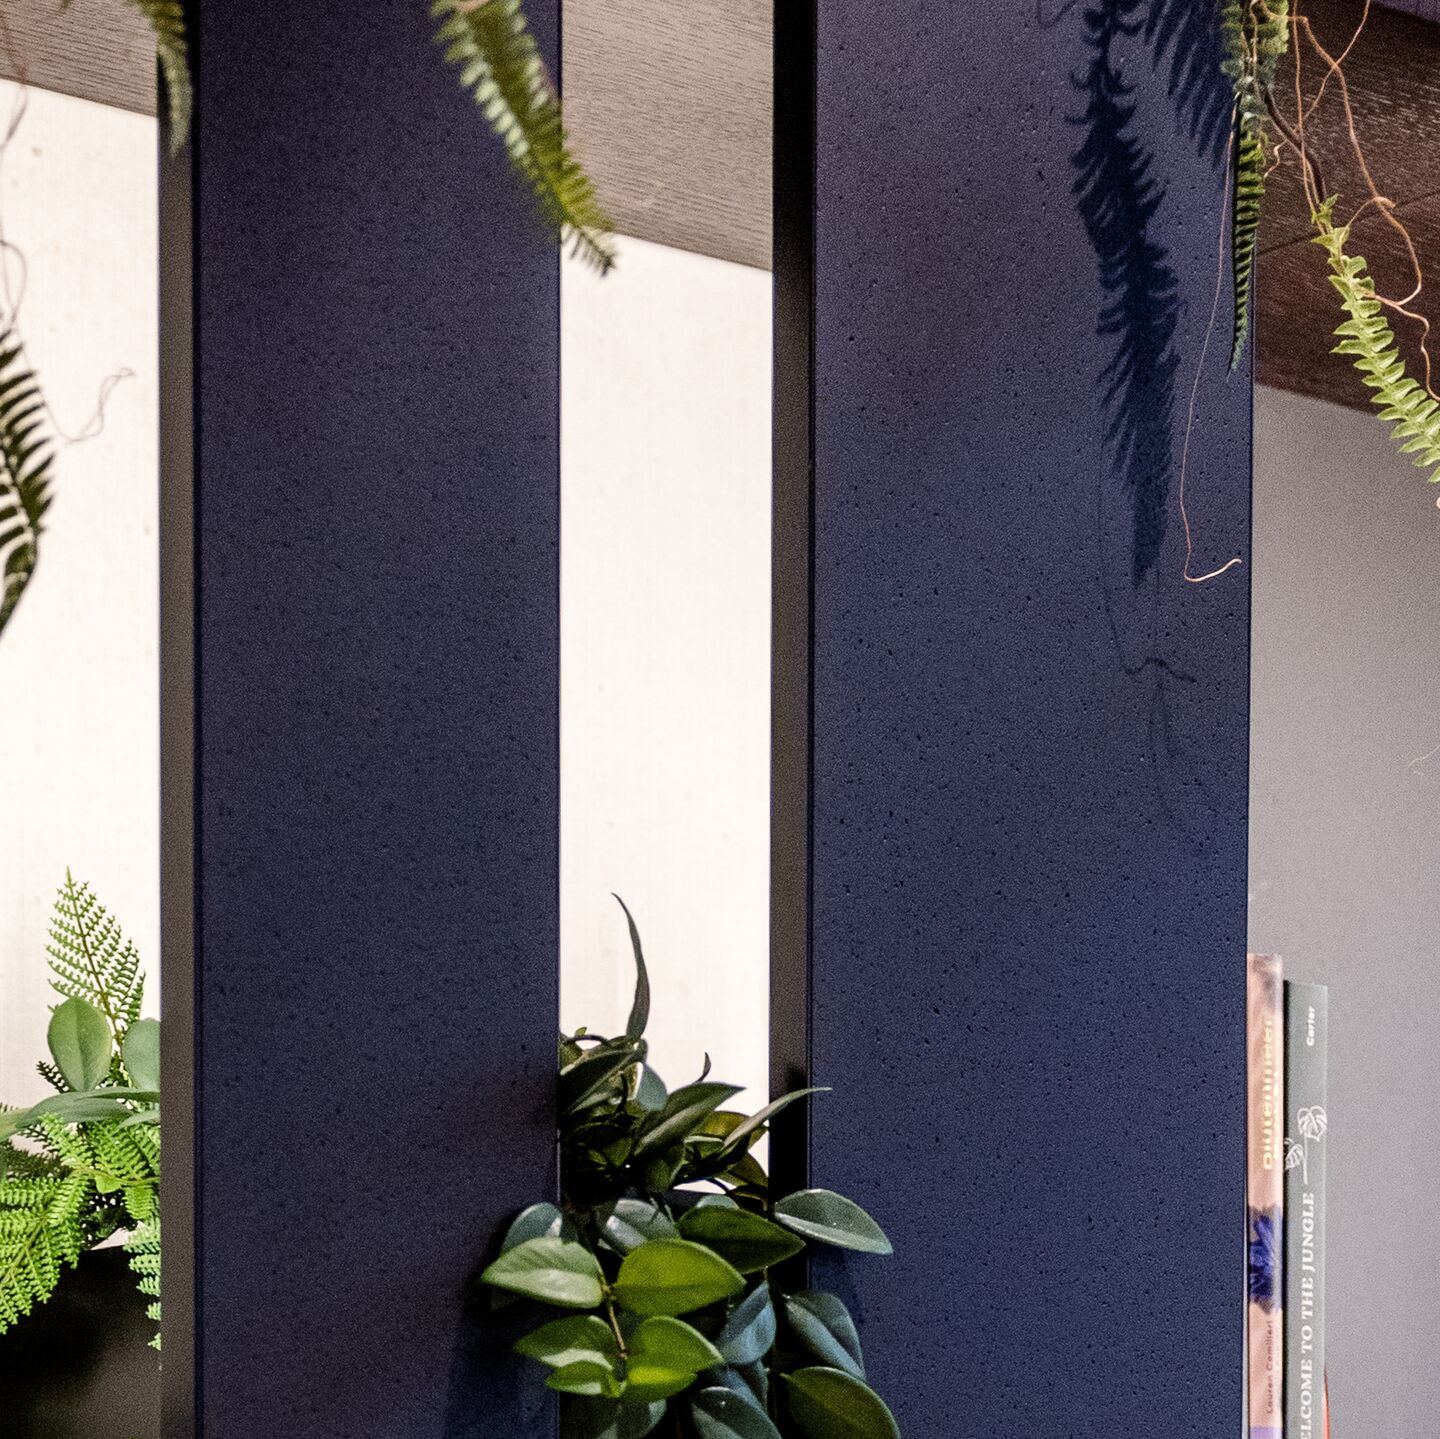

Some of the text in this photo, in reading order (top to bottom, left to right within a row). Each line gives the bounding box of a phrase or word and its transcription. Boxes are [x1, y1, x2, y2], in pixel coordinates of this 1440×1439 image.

[1301, 1192, 1317, 1274] JUNGLE
[1301, 1277, 1315, 1320] THE
[1301, 1324, 1313, 1355] TO
